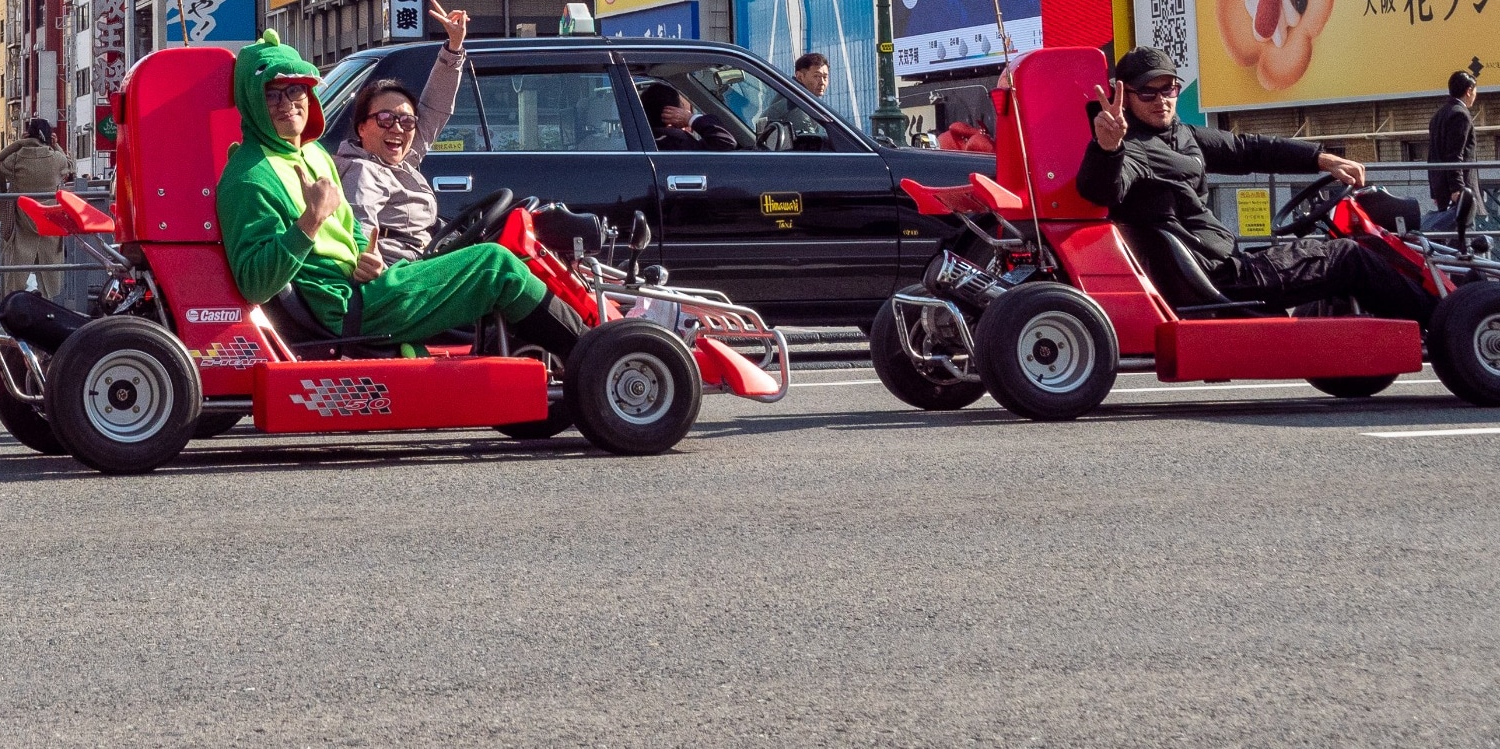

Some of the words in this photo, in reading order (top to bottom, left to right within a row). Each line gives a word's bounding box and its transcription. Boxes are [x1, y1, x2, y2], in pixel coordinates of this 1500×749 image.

[898, 47, 920, 66] 天気予報
[764, 195, 799, 213] Himawari
[775, 219, 793, 229] Taxi
[200, 310, 240, 321] Castrol
[344, 398, 391, 410] 50
